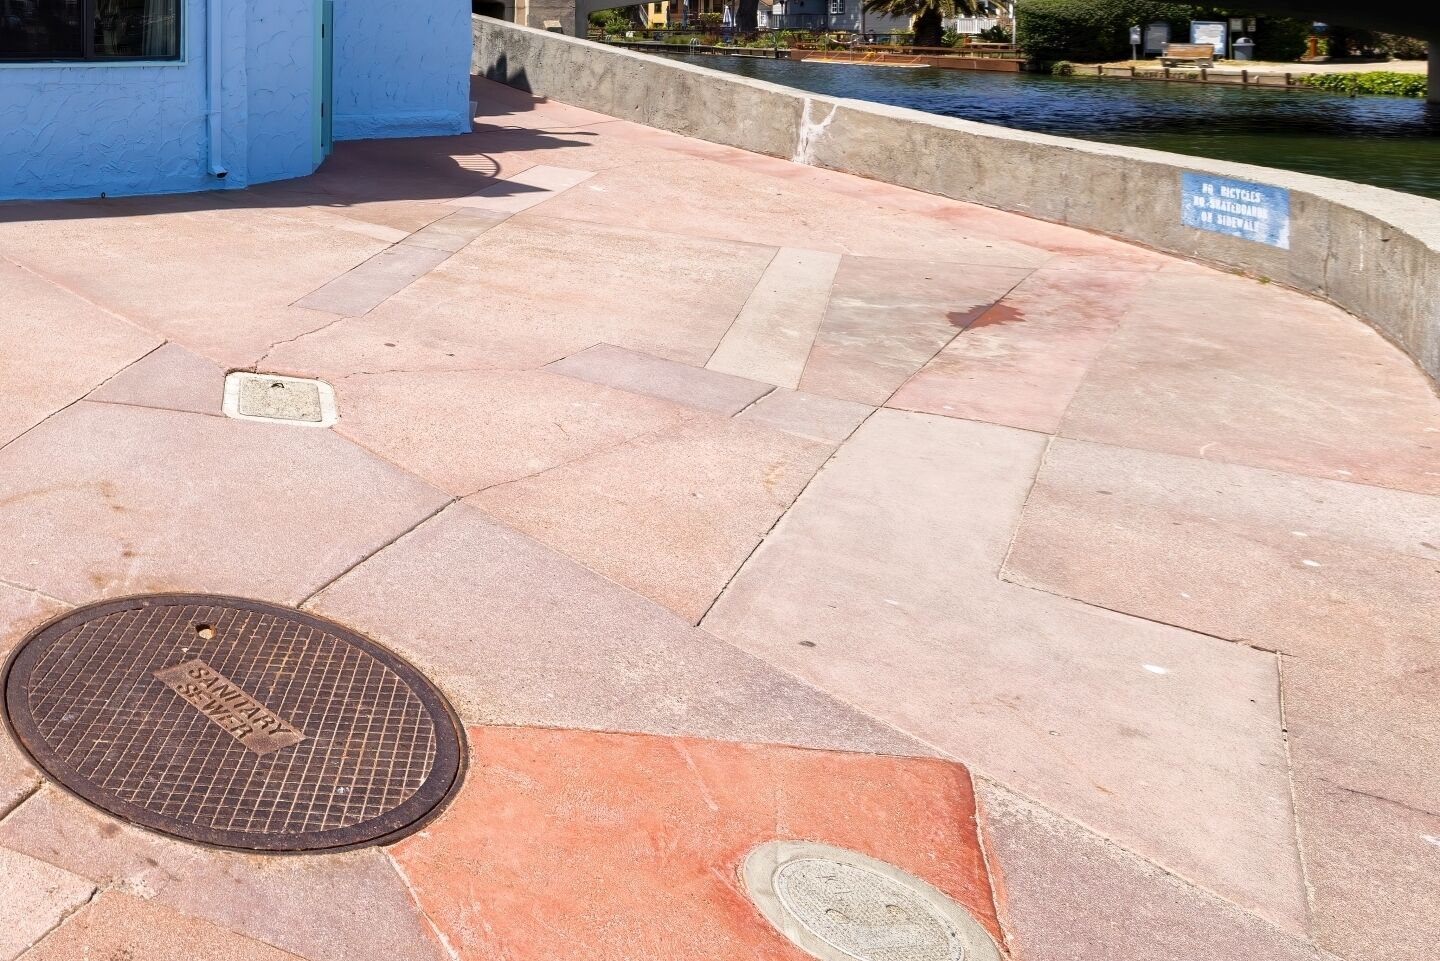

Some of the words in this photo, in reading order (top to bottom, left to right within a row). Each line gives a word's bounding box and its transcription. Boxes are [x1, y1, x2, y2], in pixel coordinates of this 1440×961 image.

[1202, 183, 1214, 194] NO
[1220, 185, 1262, 203] BICYCLES
[1193, 195, 1206, 208] NO
[1209, 196, 1269, 219] SKATEBOARDS
[1201, 211, 1213, 223] ON
[177, 683, 254, 739] SEWER
[188, 667, 291, 736] SANITARY
